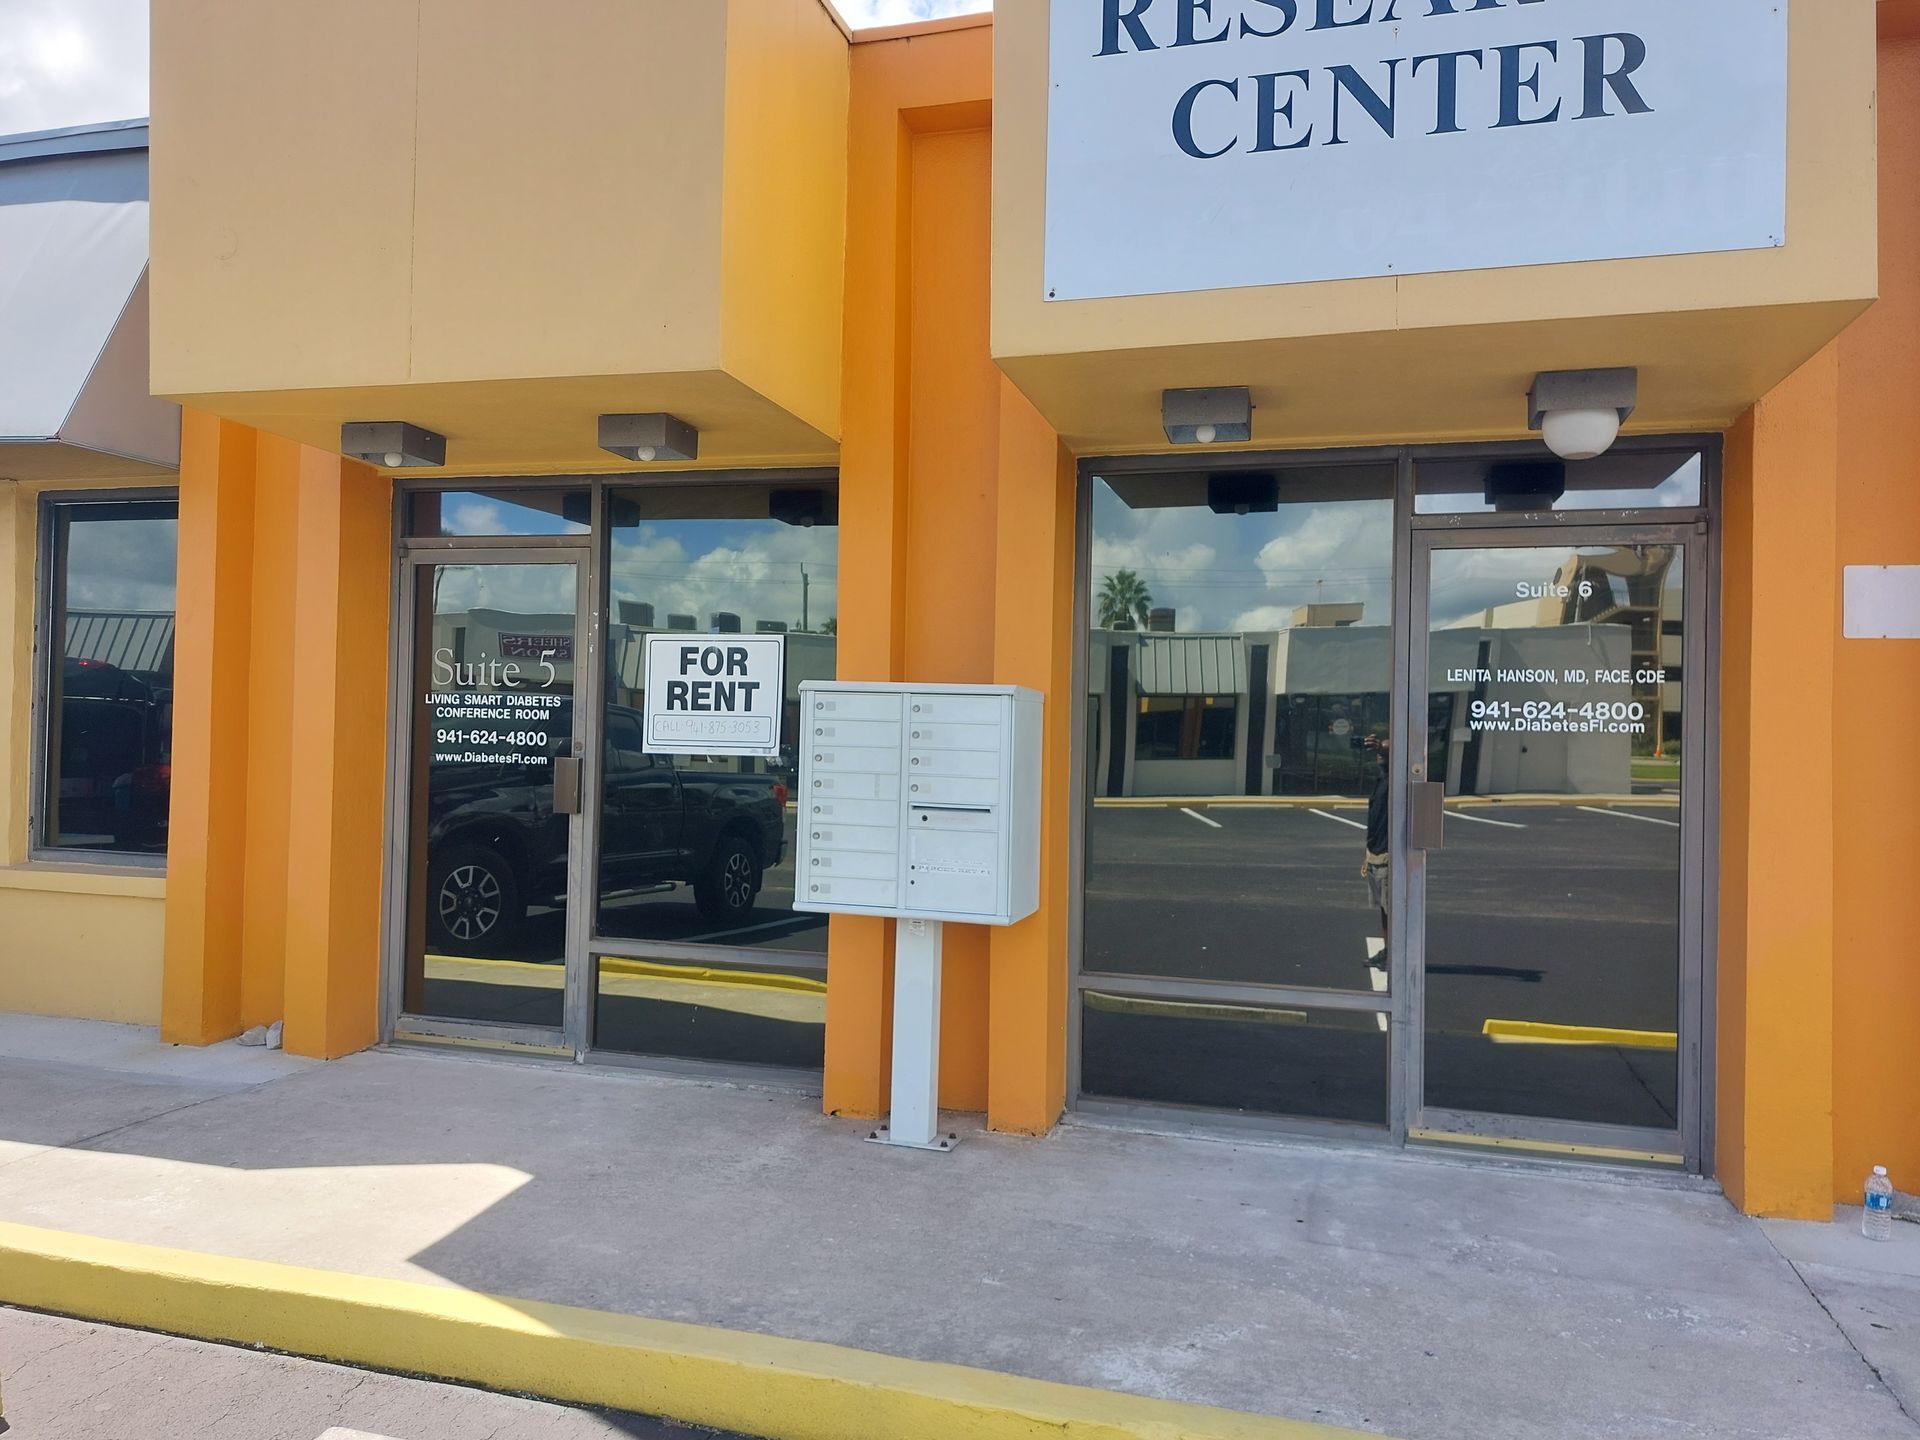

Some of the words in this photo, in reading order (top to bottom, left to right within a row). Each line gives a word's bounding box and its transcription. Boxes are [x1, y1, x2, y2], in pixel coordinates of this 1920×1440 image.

[1171, 31, 1655, 159] CENTER
[1515, 581, 1569, 598] Suite
[1578, 581, 1593, 598] 6
[432, 648, 521, 687] Suite
[539, 649, 557, 688] 5
[680, 646, 748, 676] FOR
[1447, 669, 1492, 682] LENITA
[1497, 669, 1558, 685] HANSON,
[1564, 669, 1589, 685] MD,
[425, 694, 460, 705] LIVING
[464, 695, 502, 706] SMART
[507, 695, 561, 707] DIABETES
[666, 680, 760, 712] RENT
[436, 707, 511, 719] CONFERENCE
[515, 708, 550, 720] ROOM
[1470, 701, 1644, 720] 941-624-4800
[436, 729, 548, 746] 941-624-4800
